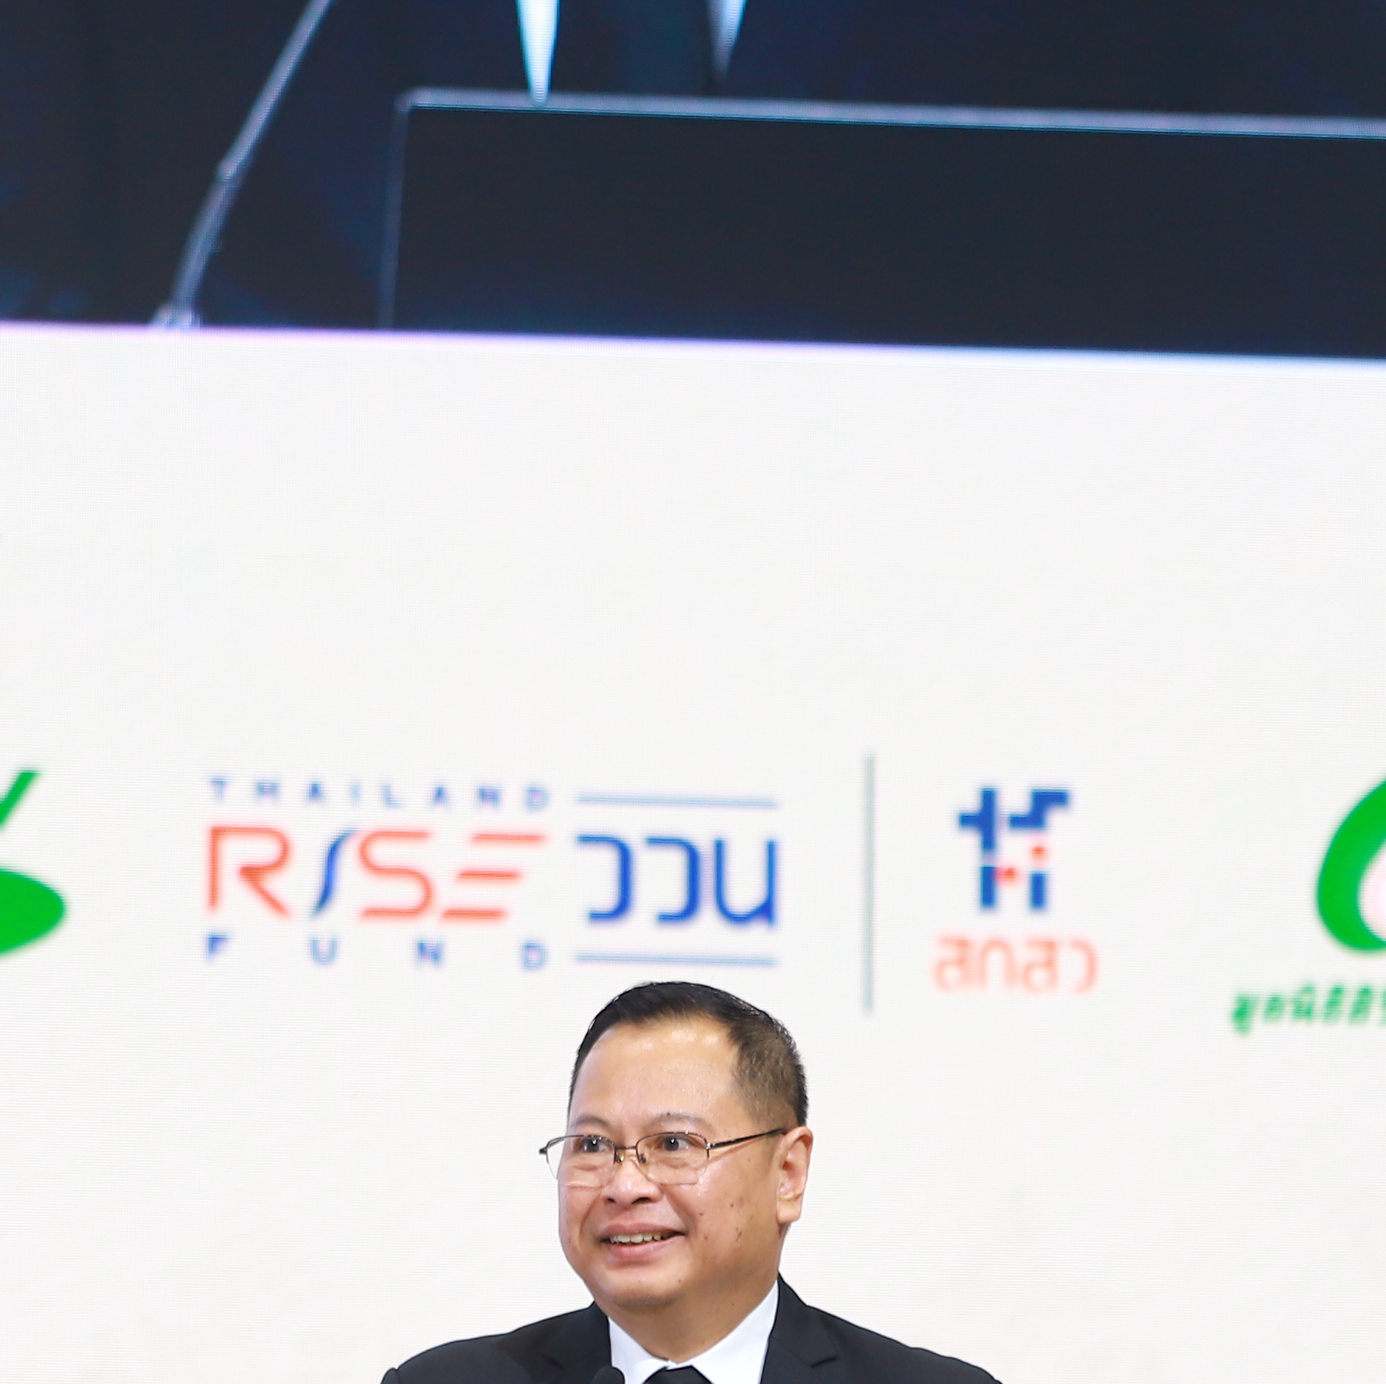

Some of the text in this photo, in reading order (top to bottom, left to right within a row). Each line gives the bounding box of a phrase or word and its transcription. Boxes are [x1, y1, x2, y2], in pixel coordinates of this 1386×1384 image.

[209, 776, 549, 811] THAILAND
[208, 825, 544, 921] RISE
[577, 834, 777, 927] ววน
[205, 931, 548, 970] FUND
[934, 936, 1097, 992] สกสว
